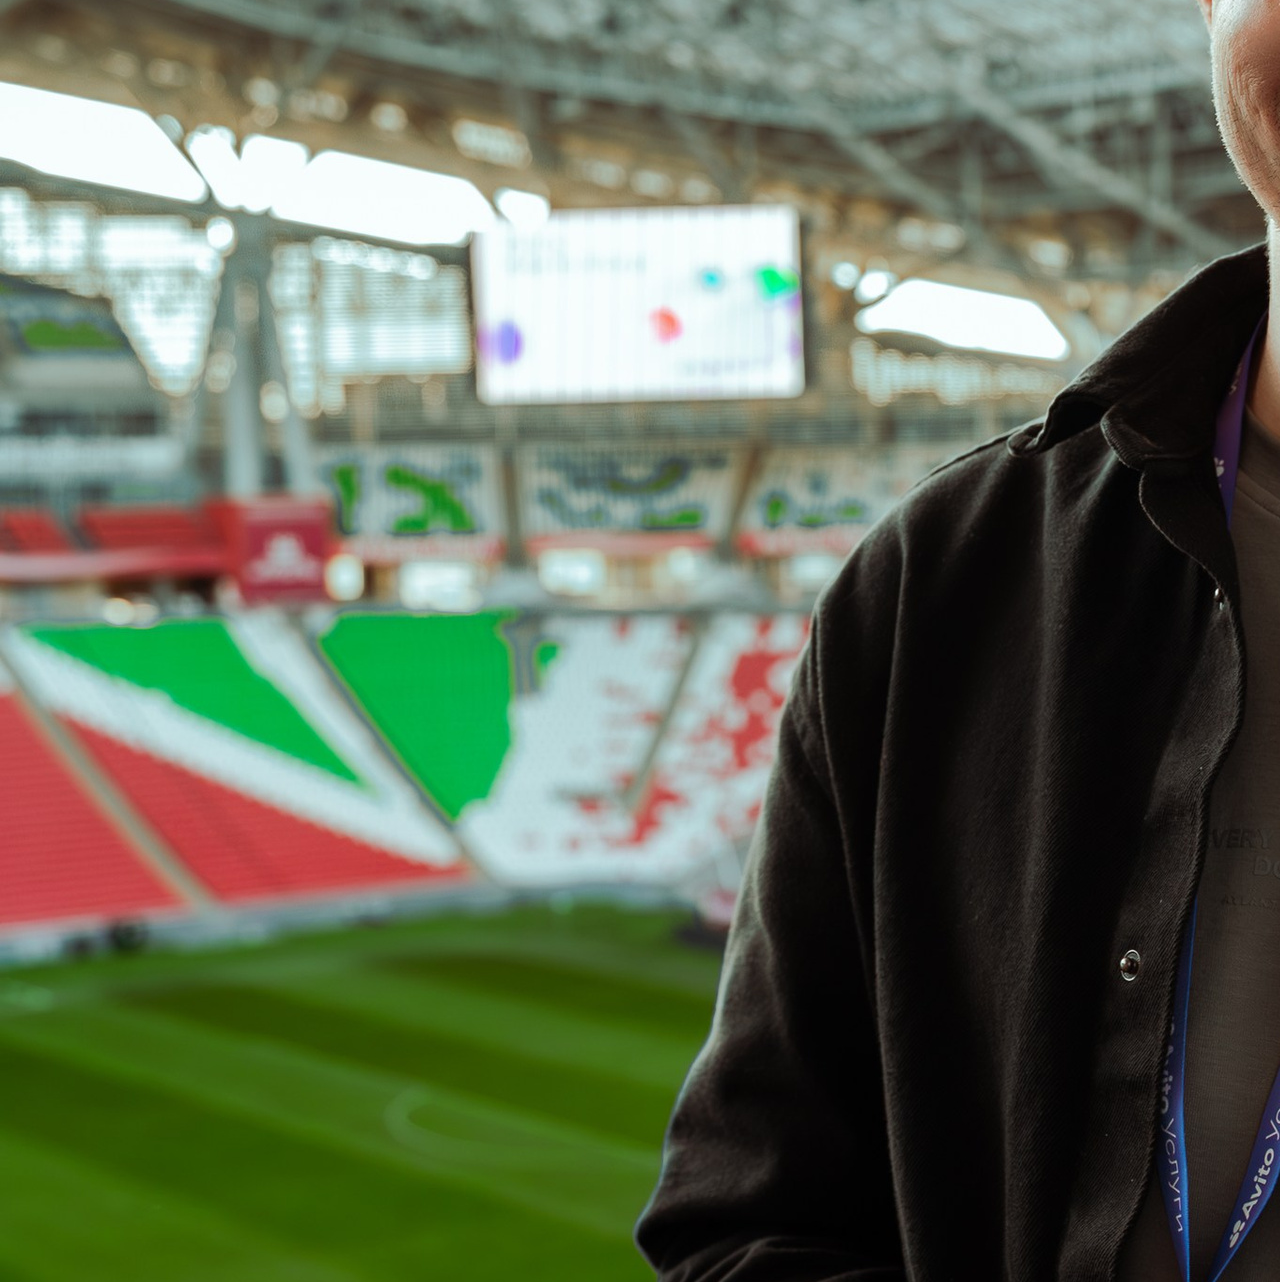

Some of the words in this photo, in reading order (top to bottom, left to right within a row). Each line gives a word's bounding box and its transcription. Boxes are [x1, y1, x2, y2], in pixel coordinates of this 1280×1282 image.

[1212, 828, 1273, 849] VERY
[1161, 1117, 1183, 1232] Услуги
[1242, 1148, 1275, 1219] Avito
